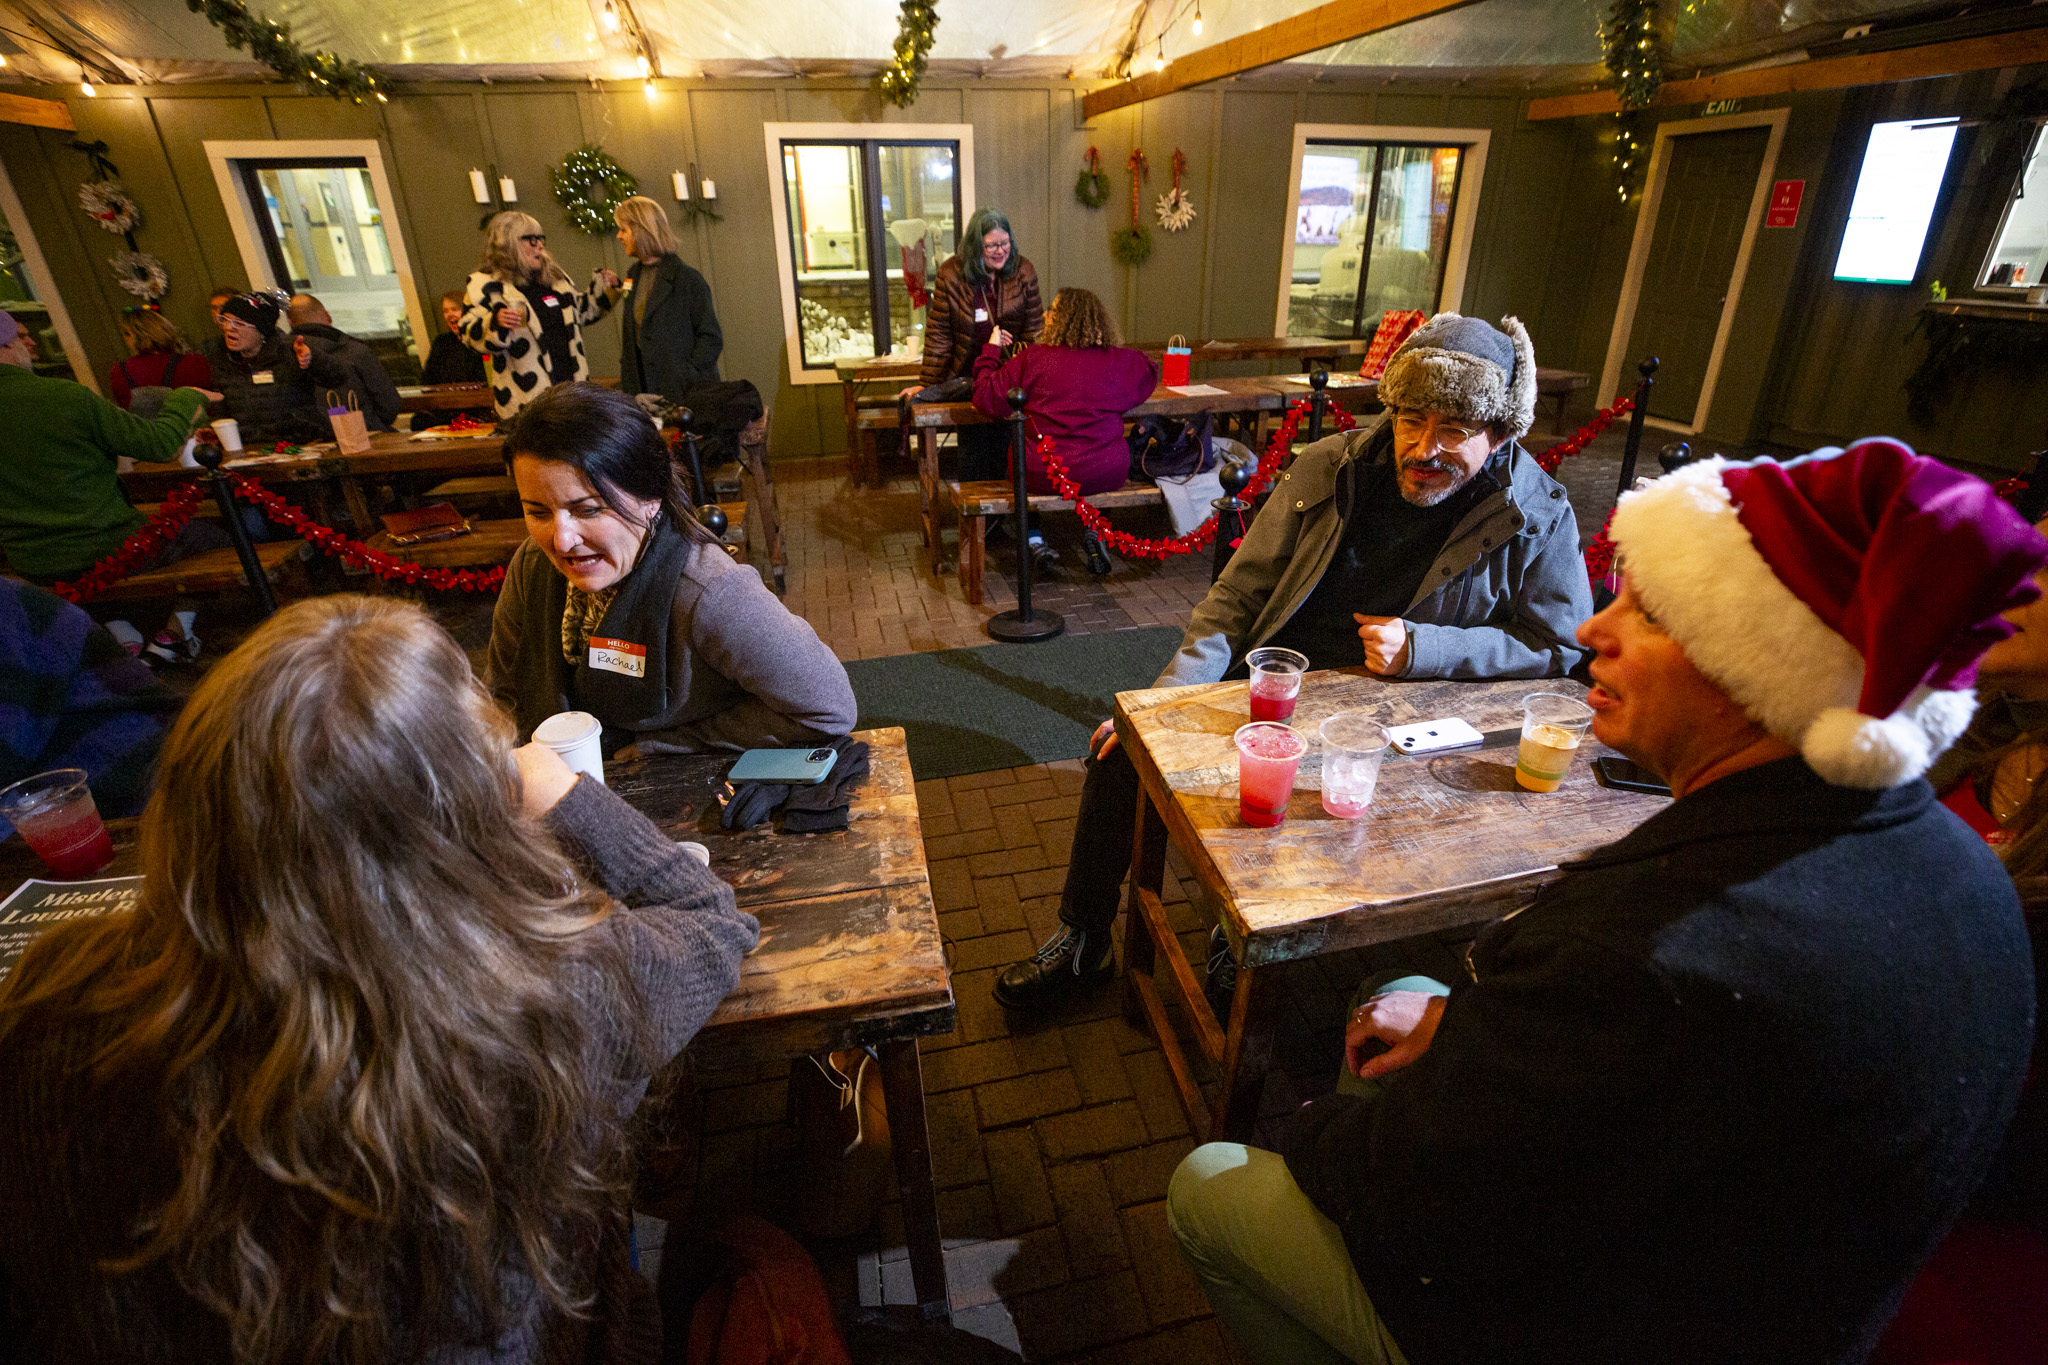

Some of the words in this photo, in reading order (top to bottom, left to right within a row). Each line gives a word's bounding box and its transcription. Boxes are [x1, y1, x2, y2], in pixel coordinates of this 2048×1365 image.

[607, 640, 630, 650] HELLO
[597, 651, 643, 672] Rachael
[33, 887, 144, 908] Mistlet
